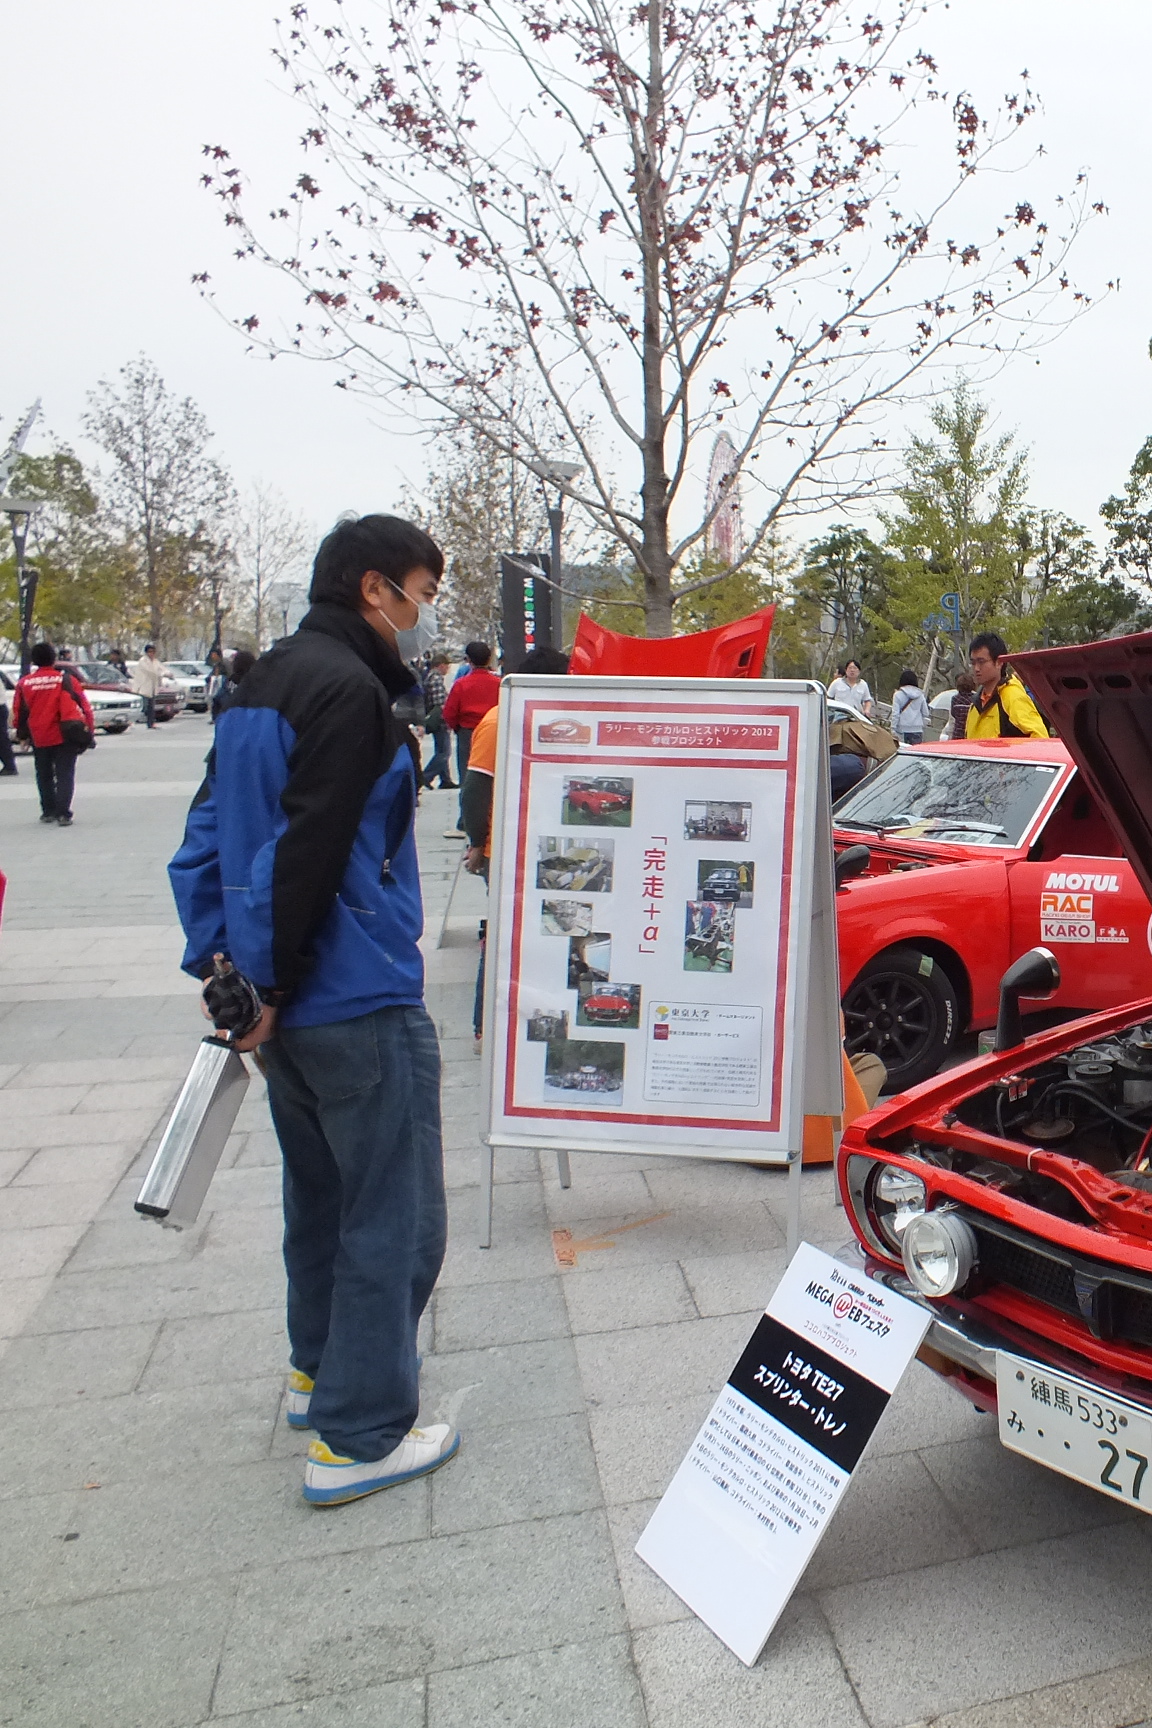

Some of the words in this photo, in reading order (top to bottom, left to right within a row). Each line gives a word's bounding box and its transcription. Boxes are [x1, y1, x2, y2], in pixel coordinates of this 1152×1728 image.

[652, 735, 722, 746] 参戦プロジェクト
[751, 727, 773, 736] 2012
[1045, 872, 1120, 892] MOTUL
[1042, 895, 1091, 913] RAC
[1044, 925, 1090, 937] KARO
[805, 1280, 836, 1308] MEGA
[781, 1350, 814, 1383] トヨタ
[808, 1367, 845, 1404] TE27
[1031, 1376, 1073, 1416] 練馬
[1078, 1395, 1118, 1435] 533
[1007, 1409, 1026, 1433] み
[1098, 1439, 1149, 1500] 27
